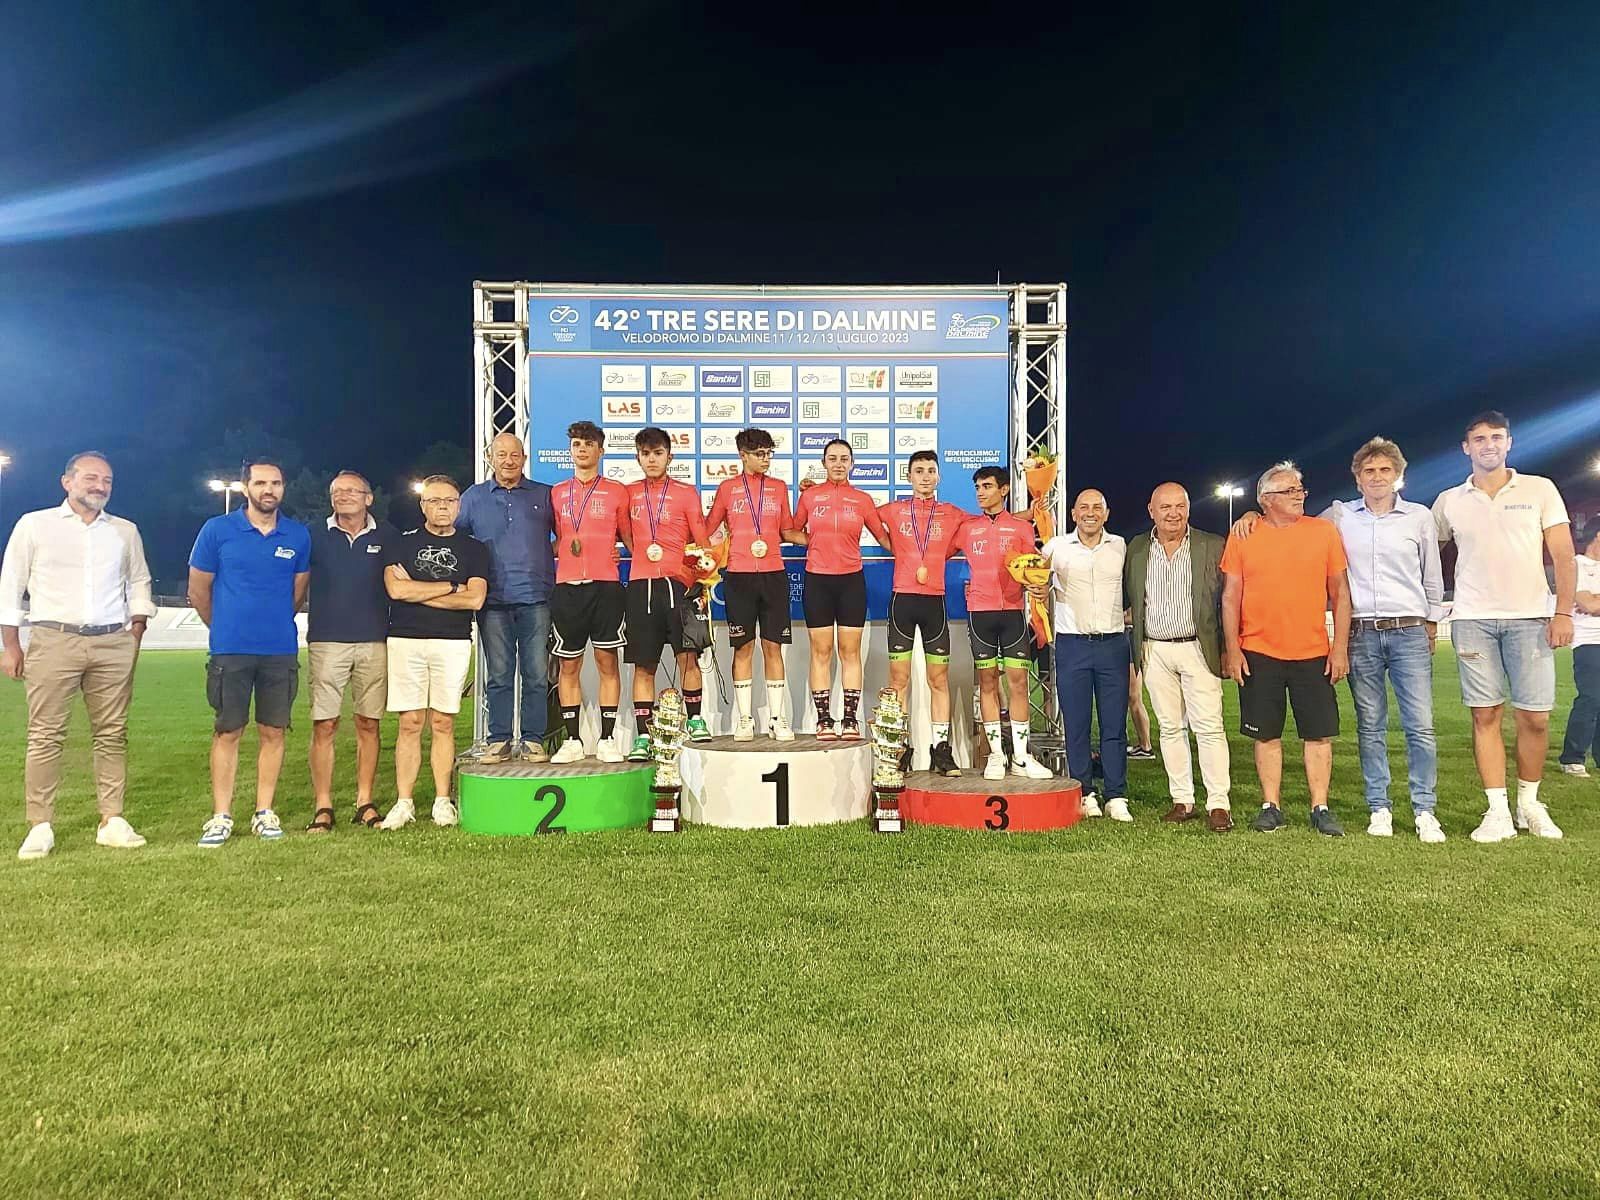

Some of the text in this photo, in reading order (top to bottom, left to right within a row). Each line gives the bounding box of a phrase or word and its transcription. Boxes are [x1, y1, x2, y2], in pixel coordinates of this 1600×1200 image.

[594, 309, 937, 331] 42° TRE SERE DI DALMINE
[622, 333, 700, 344] VELODROMO
[702, 333, 715, 344] DI
[717, 333, 770, 344] DALMINE
[821, 333, 834, 344] 13
[837, 333, 879, 344] LUGLIO
[881, 333, 910, 344] 2023
[705, 374, 738, 383] Santini
[607, 402, 641, 414] LAS
[754, 405, 788, 415] Santini
[671, 433, 690, 445] AS
[706, 464, 739, 476] LAS
[851, 467, 884, 477] Santini
[761, 762, 789, 826] 1
[533, 784, 567, 834] 2
[984, 795, 1009, 831] 3
